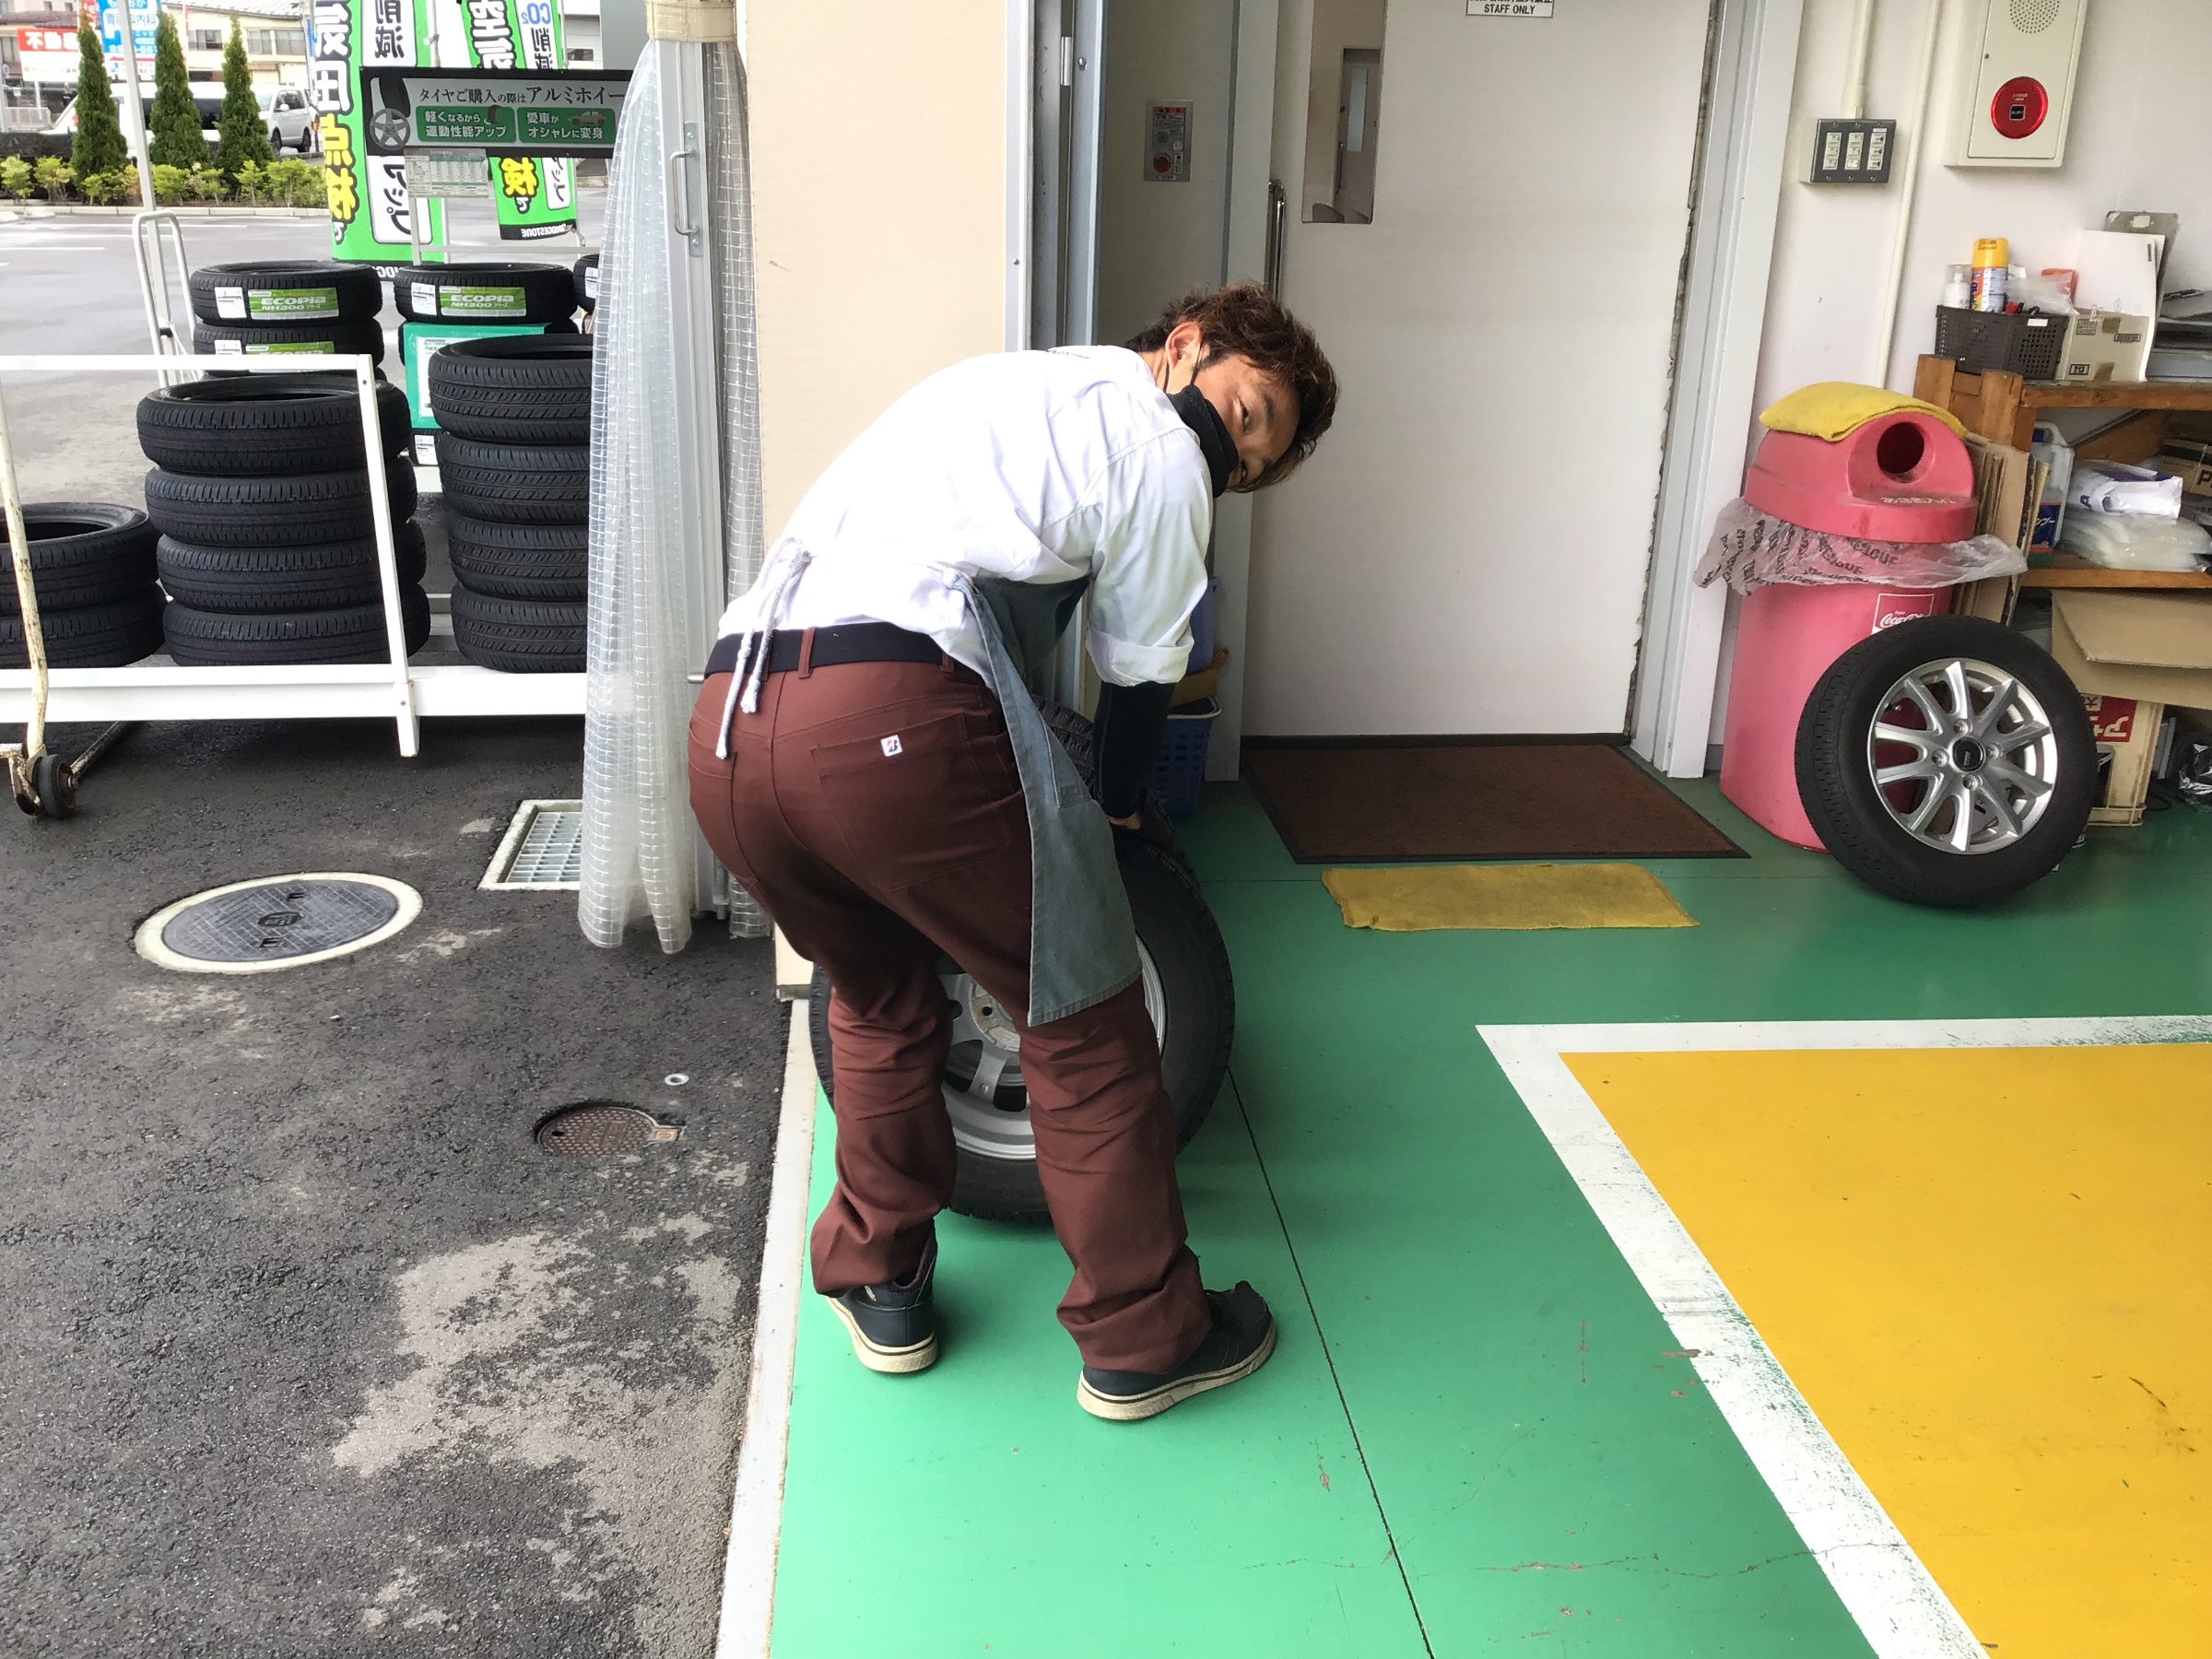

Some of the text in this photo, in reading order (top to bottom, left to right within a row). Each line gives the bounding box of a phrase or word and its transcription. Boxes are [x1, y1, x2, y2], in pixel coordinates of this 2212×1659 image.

[1484, 4, 1535, 15] STAFF ONLY
[526, 112, 559, 124] 愛車が
[426, 125, 507, 137] 運動性能アップ
[528, 126, 603, 139] オシャレに変身
